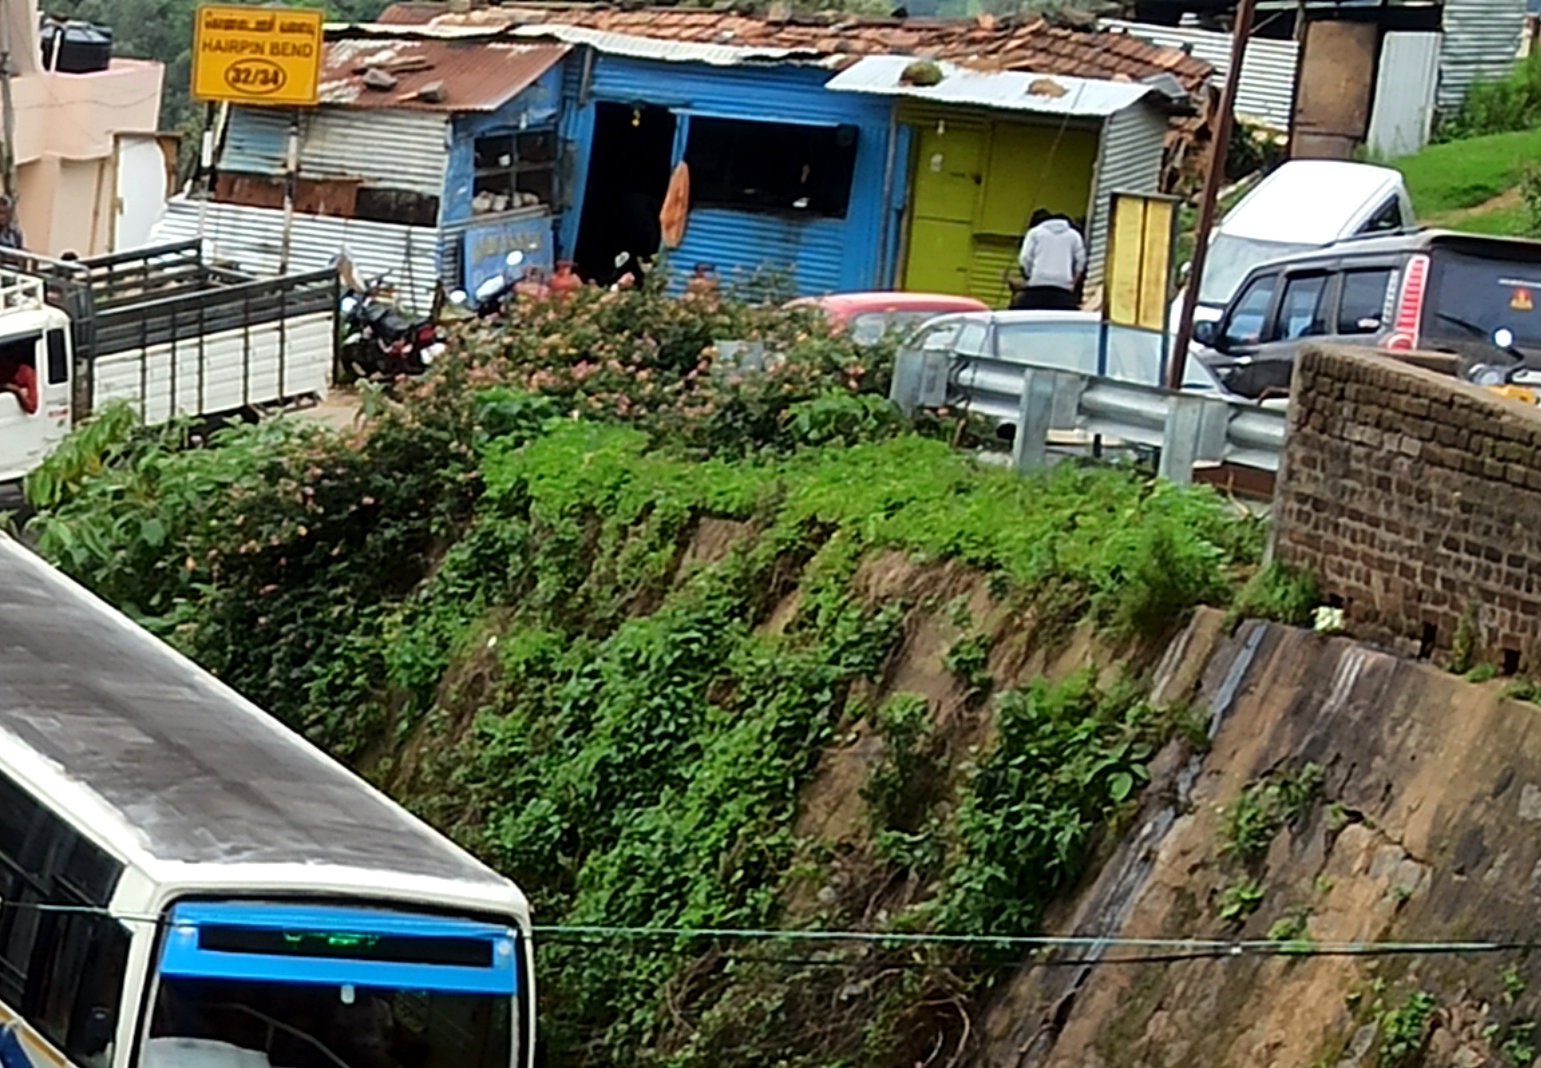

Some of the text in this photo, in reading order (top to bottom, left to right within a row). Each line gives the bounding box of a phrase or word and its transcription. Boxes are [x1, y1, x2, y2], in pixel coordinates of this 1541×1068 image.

[201, 38, 313, 58] HAIRPIN BEND
[231, 67, 280, 86] 32/34
